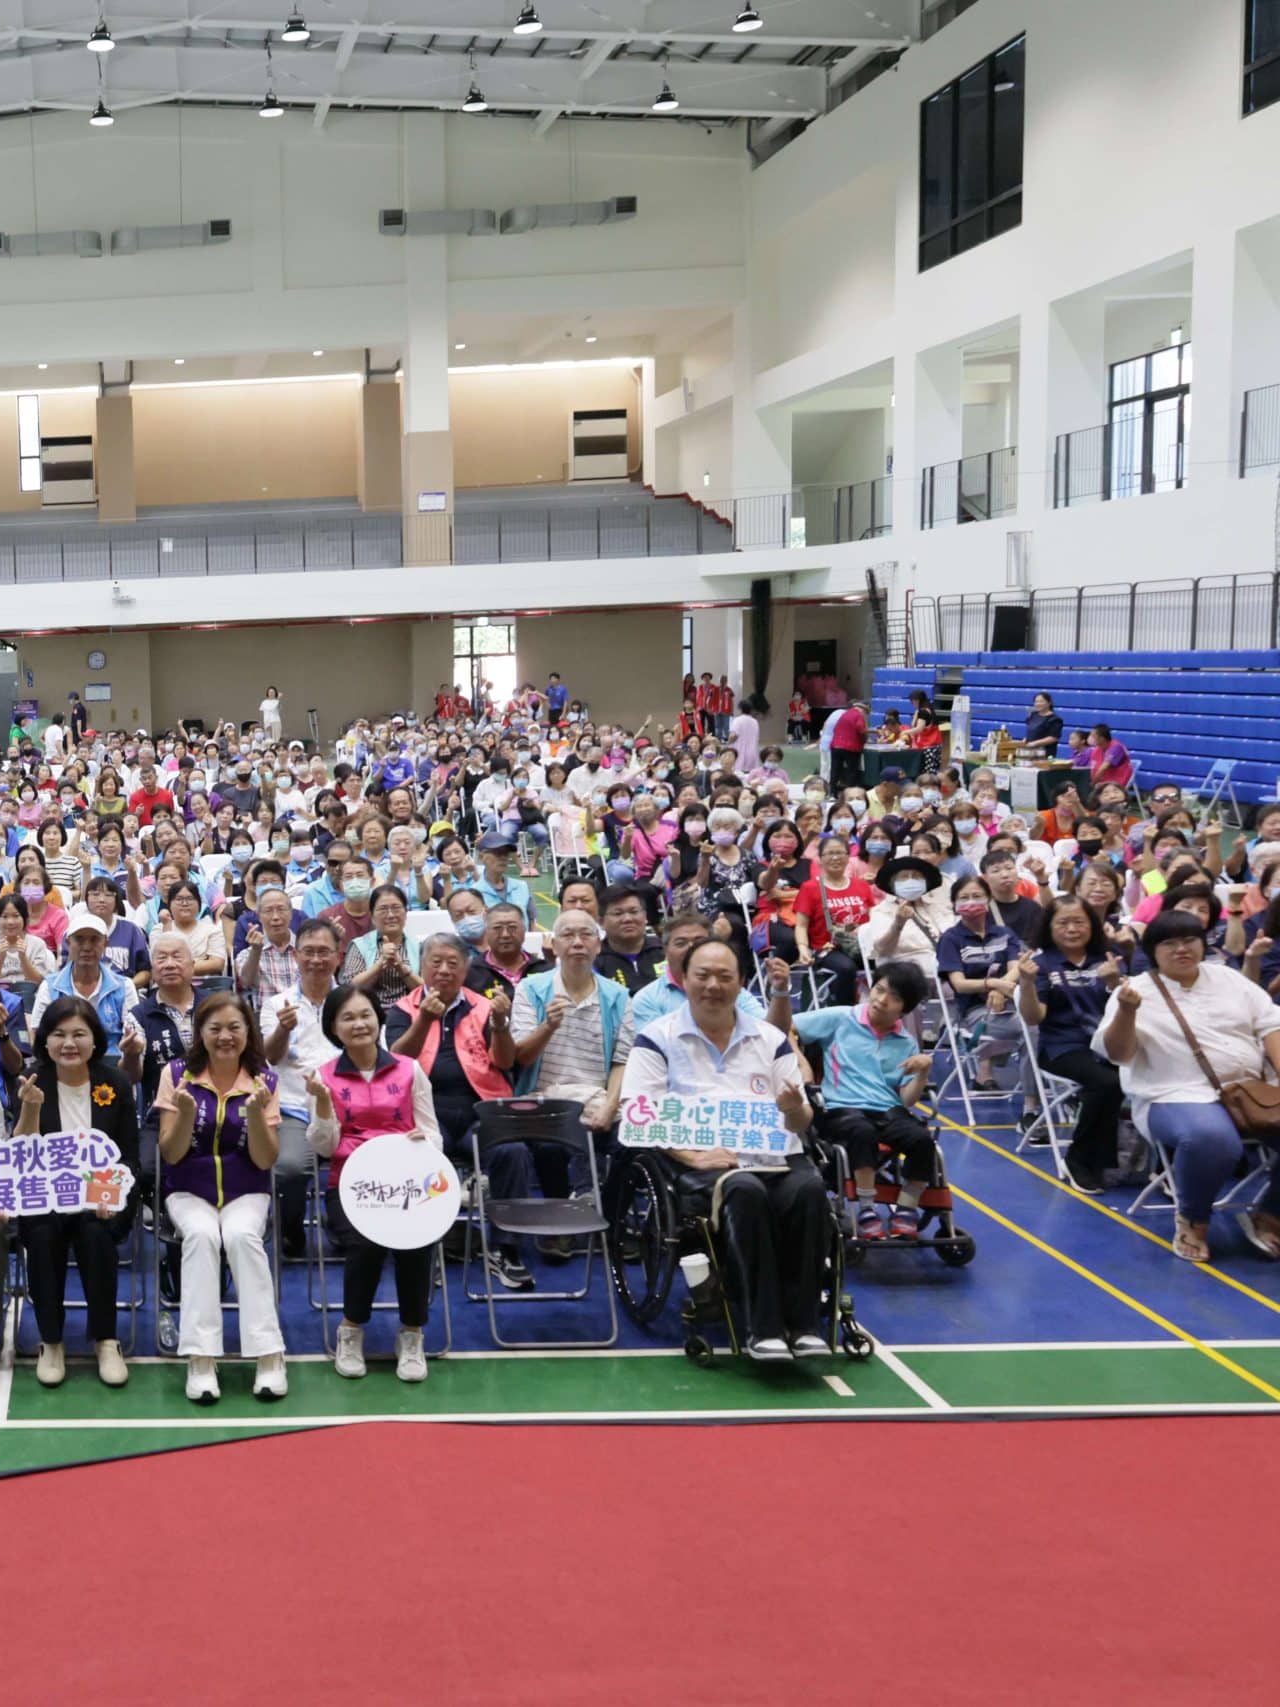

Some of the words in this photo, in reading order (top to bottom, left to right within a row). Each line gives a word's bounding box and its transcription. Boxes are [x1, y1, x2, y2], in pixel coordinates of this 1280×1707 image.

[660, 1097, 780, 1128] 身心障礙
[623, 1123, 788, 1151] 經典歌曲音樂會
